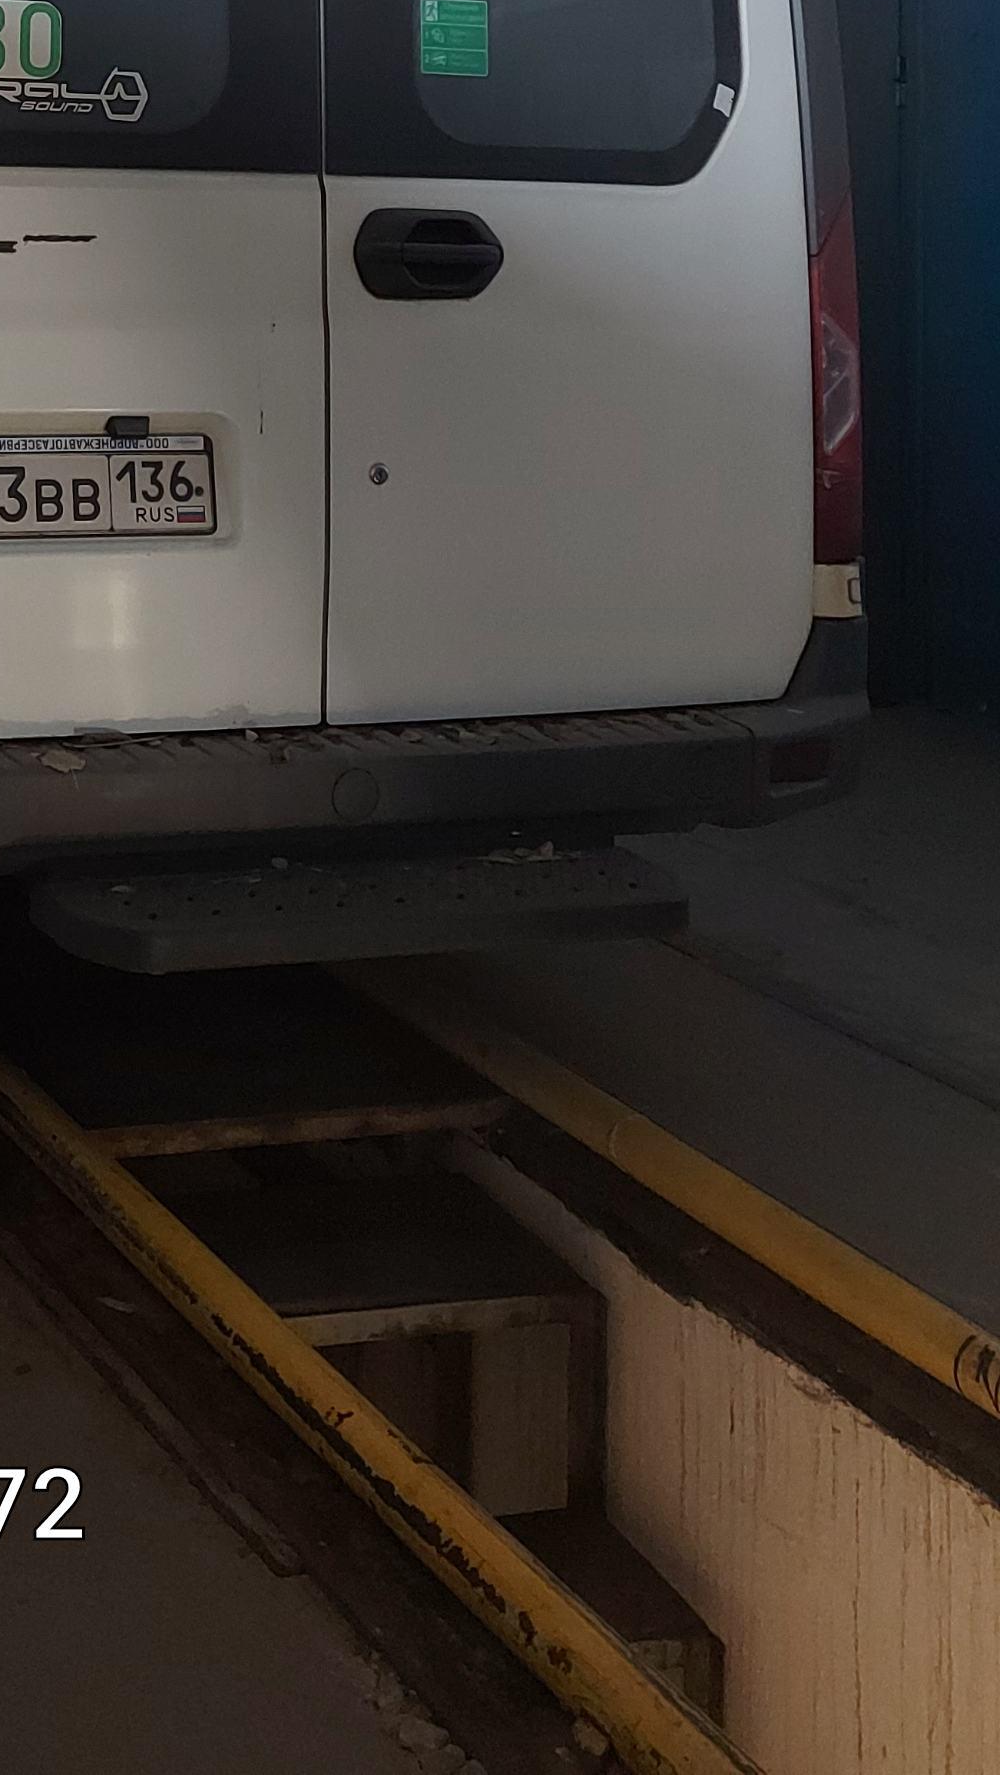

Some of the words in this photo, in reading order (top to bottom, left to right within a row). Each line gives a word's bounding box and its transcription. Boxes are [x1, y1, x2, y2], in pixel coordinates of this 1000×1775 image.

[19, 100, 93, 113] SOUND
[116, 460, 195, 503] 136
[135, 507, 174, 523] RUS
